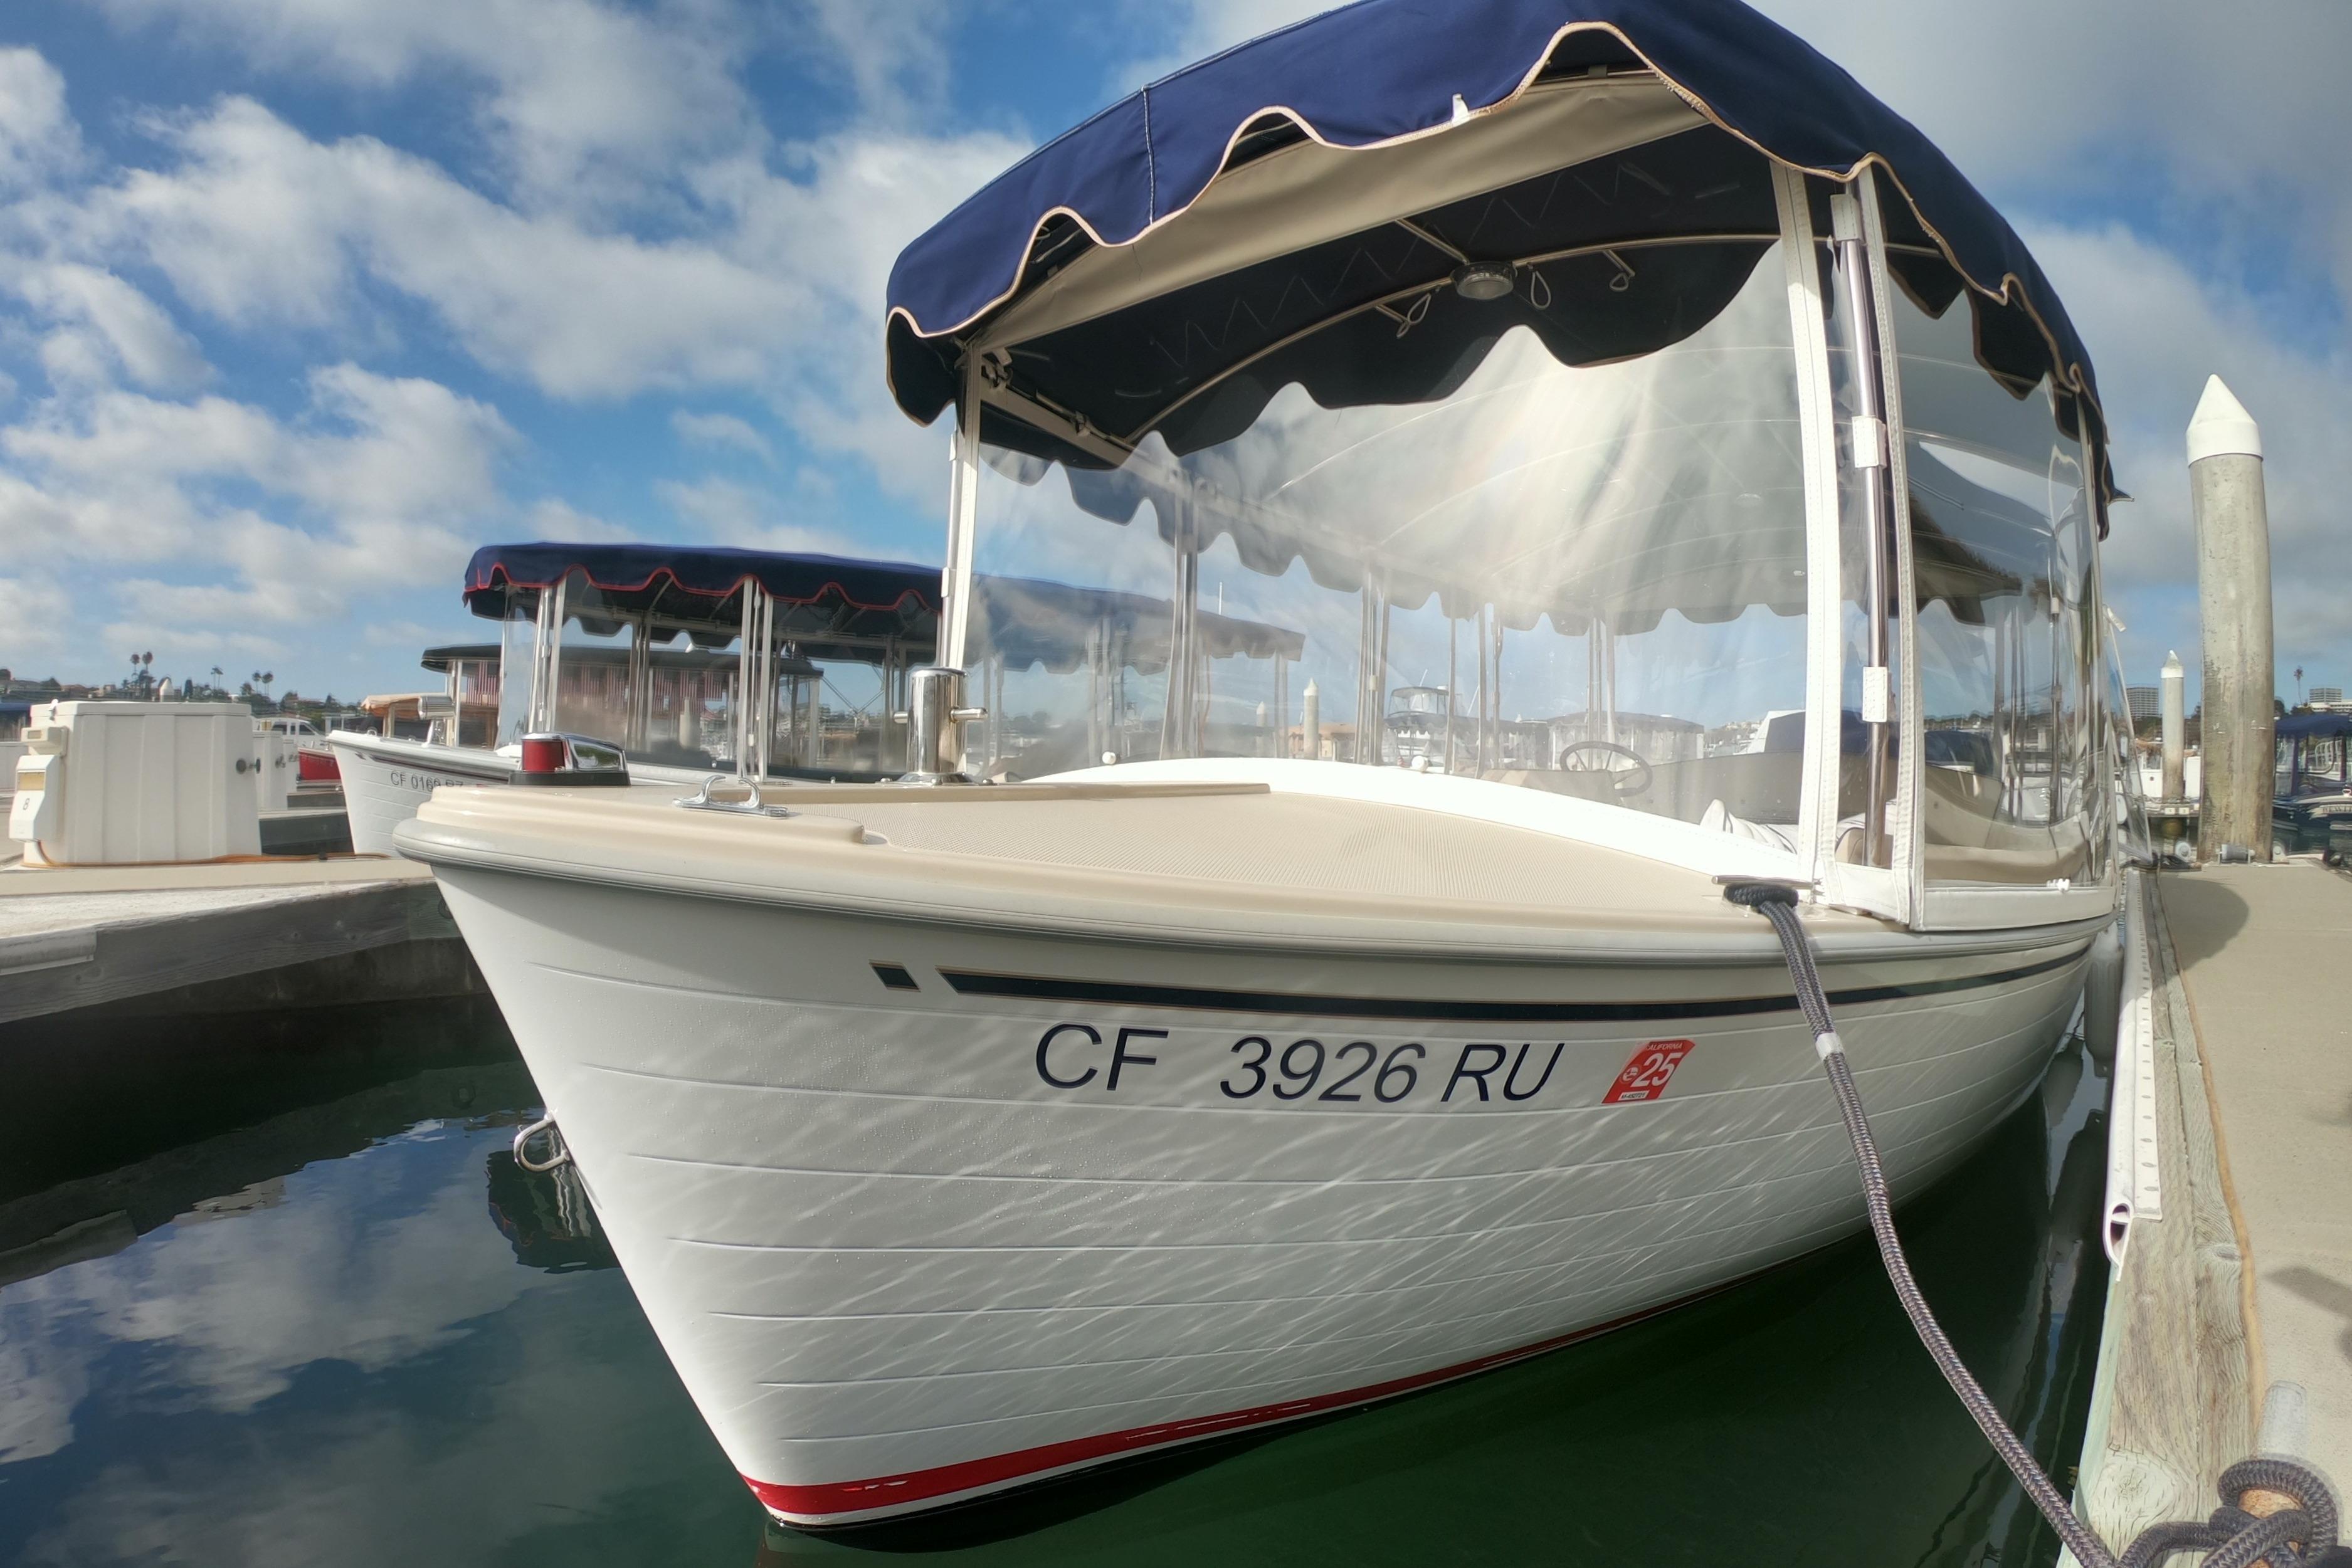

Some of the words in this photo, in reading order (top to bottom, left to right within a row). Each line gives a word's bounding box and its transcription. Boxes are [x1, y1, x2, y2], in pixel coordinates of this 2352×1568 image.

[391, 771, 406, 786] CF
[23, 798, 30, 810] 8
[1036, 1022, 1169, 1091] CF
[1220, 1034, 1426, 1103] 3926
[1440, 1043, 1566, 1102] RU
[1630, 1052, 1684, 1088] 25
